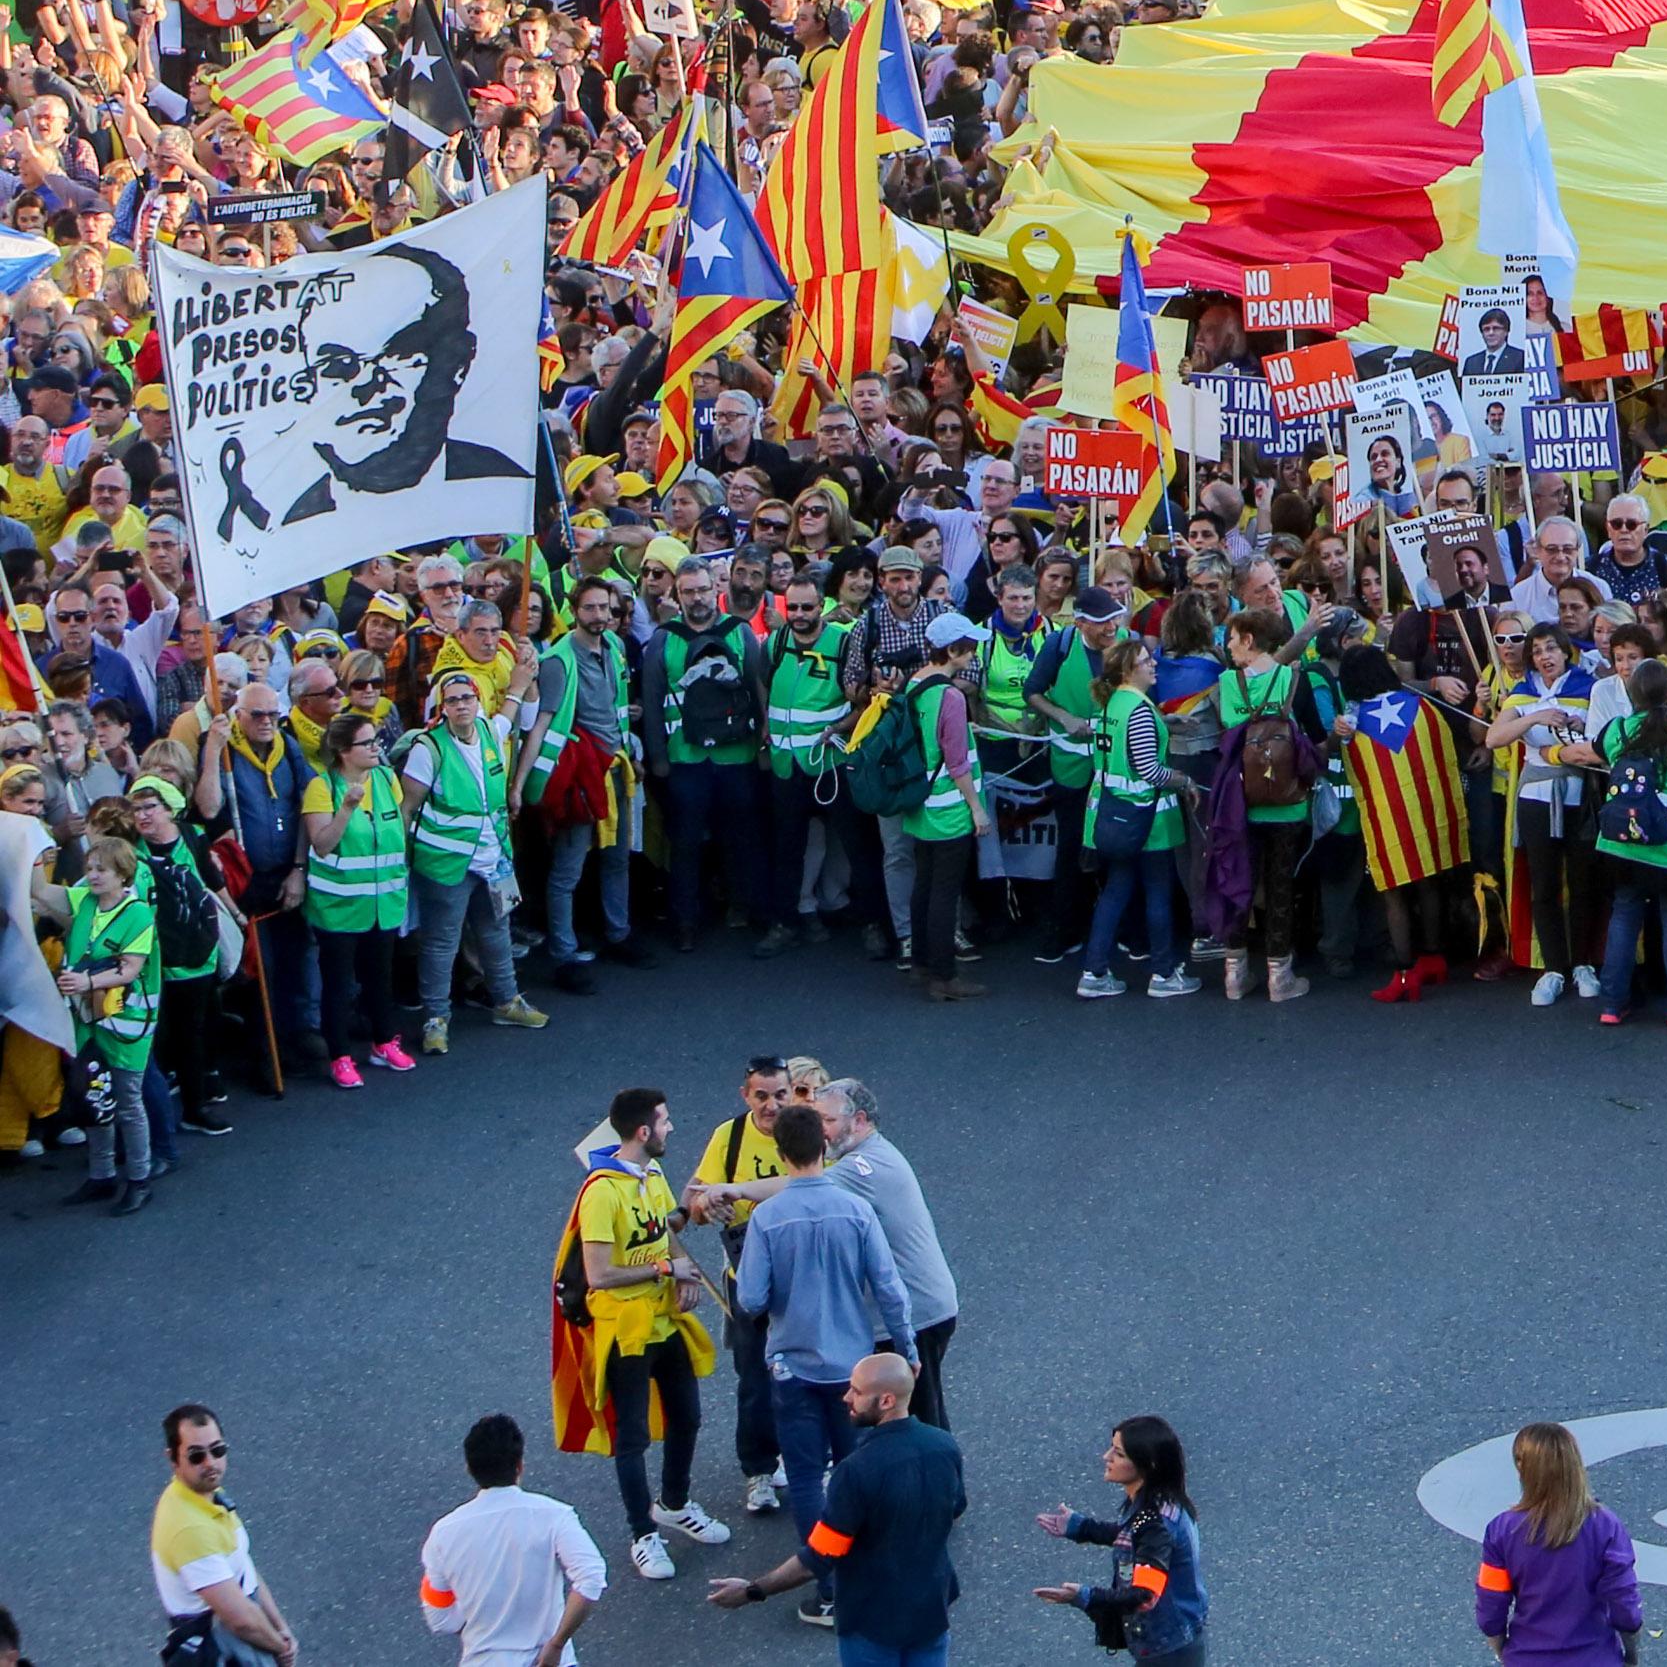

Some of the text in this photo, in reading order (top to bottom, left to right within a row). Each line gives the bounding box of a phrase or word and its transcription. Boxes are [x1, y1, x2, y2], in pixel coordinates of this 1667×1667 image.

[251, 203, 318, 223] NO ÉS DELICTE
[1505, 254, 1537, 262] Bona
[1245, 270, 1271, 296] NO
[1465, 286, 1520, 296] Bona Nit
[1247, 292, 1330, 327] PASARÁN
[1461, 296, 1525, 309] President!
[192, 324, 298, 376] PRESOS
[1266, 357, 1295, 386] NO
[1427, 373, 1446, 387] Nit
[1468, 375, 1524, 386] Bona Nit
[1356, 372, 1406, 395] Bona Nit
[1478, 386, 1514, 398] Jordi!
[1234, 379, 1273, 412] HAY
[1275, 372, 1357, 421] PASARÁN
[1372, 387, 1401, 402] Adri!
[1351, 408, 1404, 425] Bona Nit
[1531, 408, 1608, 440] NO HAY
[1361, 420, 1396, 435] Anna!
[1050, 431, 1077, 459] NO
[1530, 436, 1611, 470] JUSTÍCIA
[1049, 461, 1139, 495] PASARÁN
[1336, 465, 1348, 496] NO
[1394, 523, 1421, 536] Bona
[1429, 518, 1487, 535] Bona Nit
[1443, 532, 1479, 545] Oriol!
